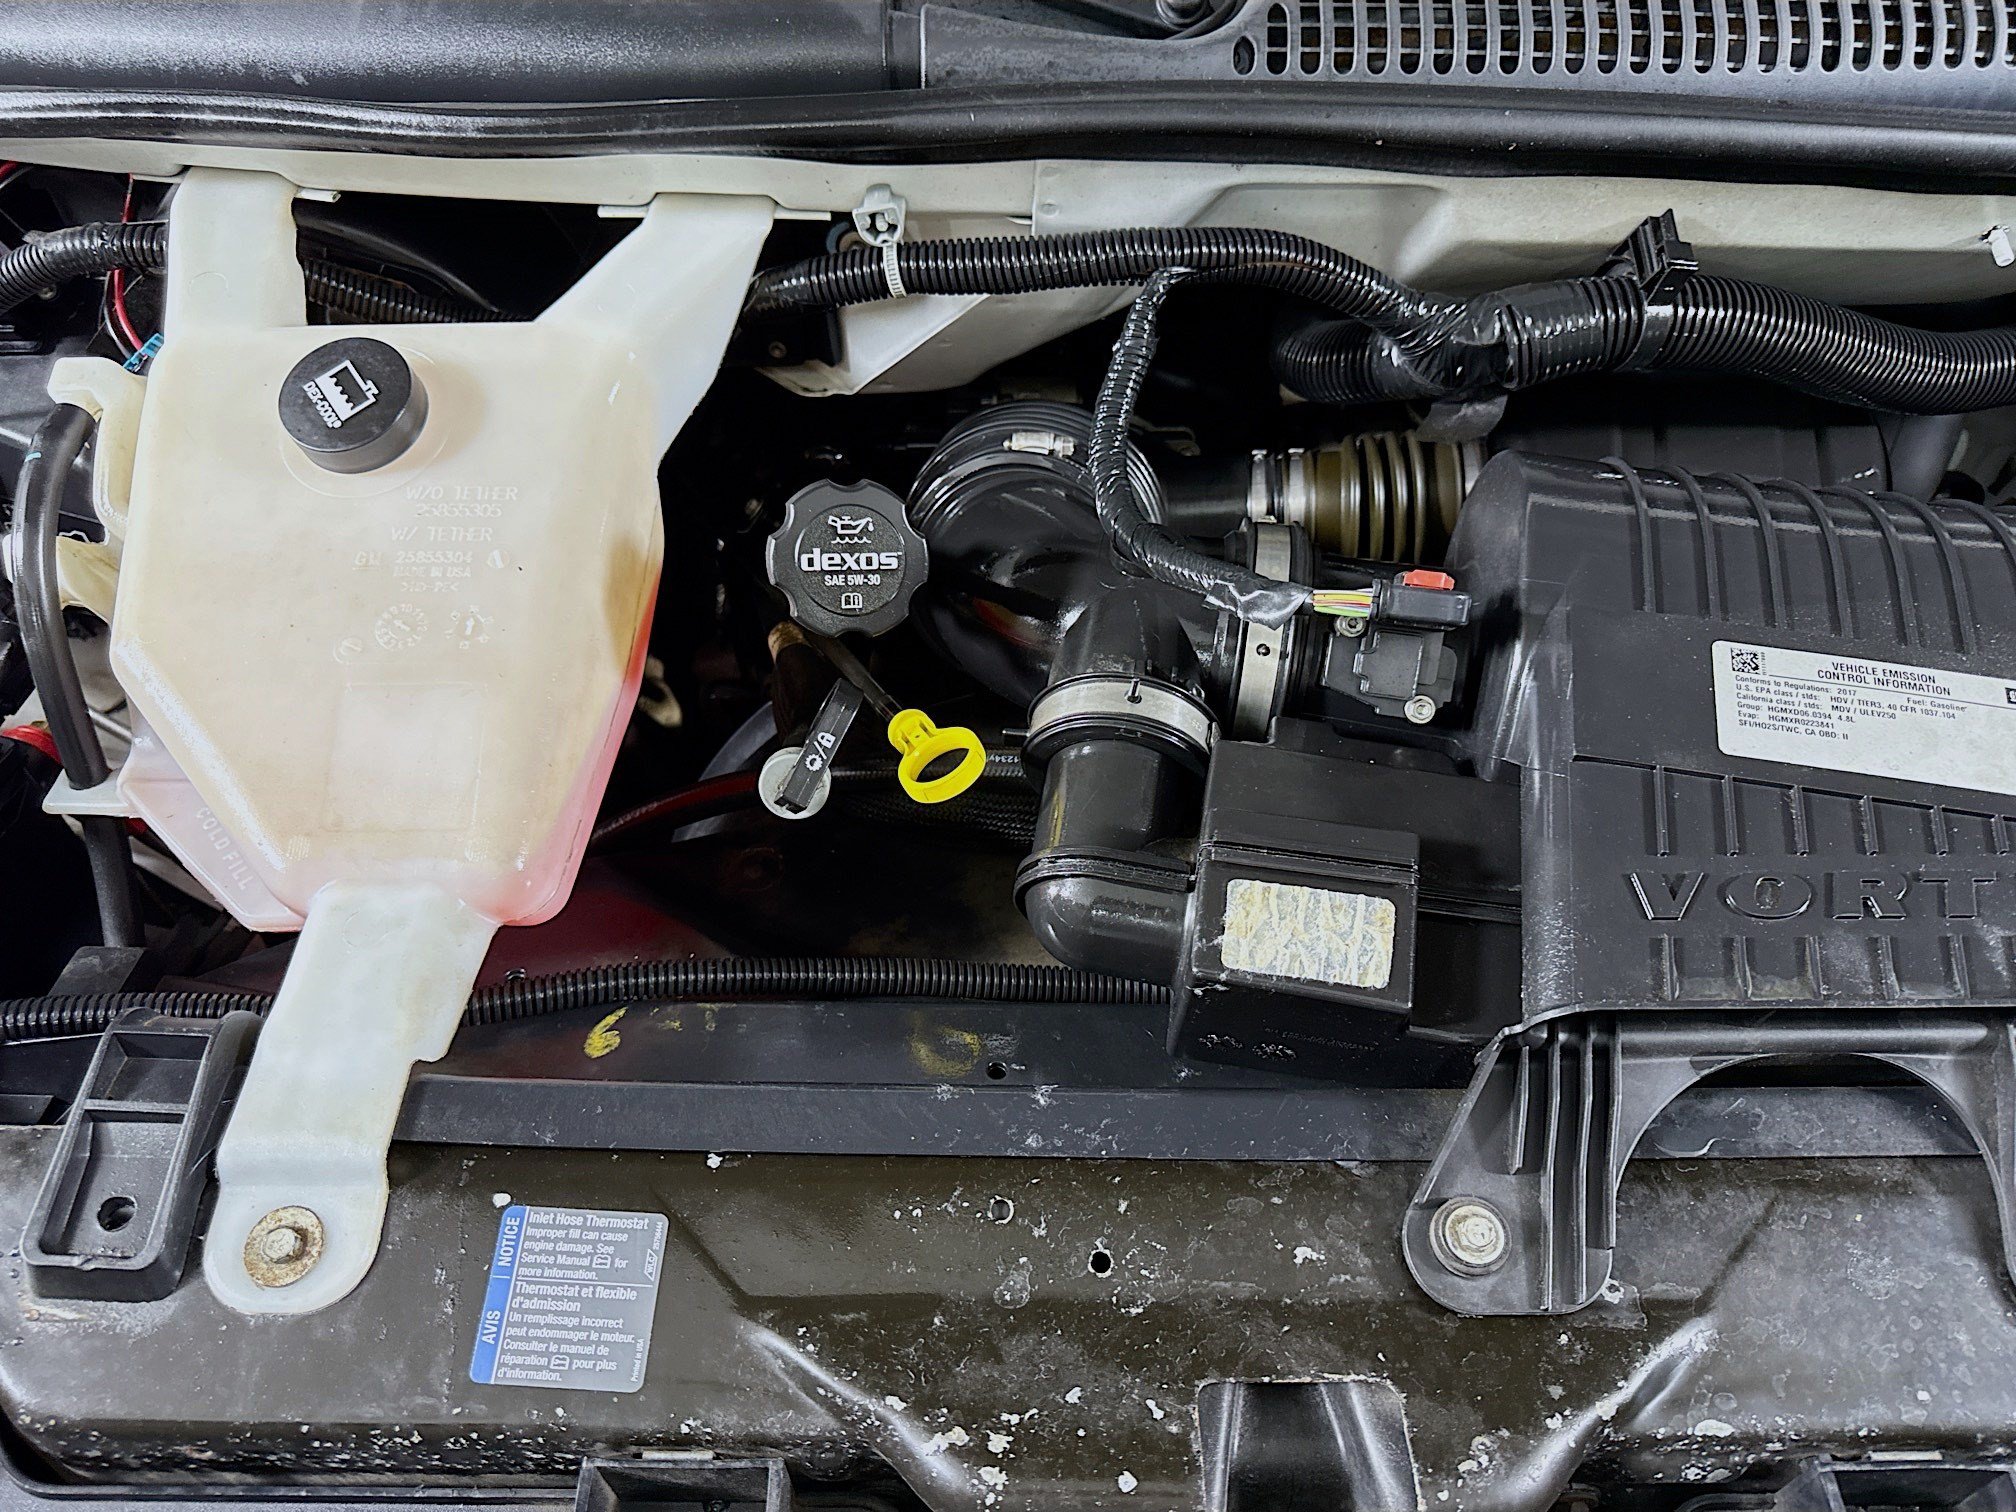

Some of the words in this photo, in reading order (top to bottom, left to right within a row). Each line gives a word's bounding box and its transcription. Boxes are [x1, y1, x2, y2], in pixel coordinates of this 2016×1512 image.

[455, 486, 518, 500] TETHER
[427, 526, 493, 541] TETHER
[800, 548, 899, 571] dexos
[824, 573, 846, 586] SAE
[847, 573, 881, 586] 5W-30
[1832, 661, 1878, 676] VEHICLE
[1883, 668, 1936, 684] EMISSION
[1735, 675, 1771, 686] Conforms
[1785, 681, 1831, 693] Regulations:
[1837, 688, 1856, 696] 2017
[1817, 670, 1870, 685] CONTROL
[1874, 676, 1951, 696] INFORMATION
[1736, 693, 1773, 704] California
[1776, 698, 1795, 707] class
[1804, 701, 1823, 710] stds:
[1831, 705, 1850, 713] MDV
[1860, 707, 1896, 719] ULEV250
[1737, 701, 1762, 711] Group:
[1755, 686, 1771, 694] EPA
[1774, 689, 1793, 698] class
[1801, 692, 1820, 701] stds:
[1830, 696, 1848, 704] HDV
[1900, 704, 1917, 713] CFR
[1907, 697, 1927, 707] Fuel:
[1738, 711, 1759, 719] Evap:
[1805, 728, 1816, 736] CA
[195, 807, 231, 850] COLD
[222, 852, 254, 890] FILL
[529, 1211, 554, 1225] Inlet
[556, 1214, 583, 1226] Hose
[586, 1215, 649, 1230] Thermostat
[498, 1217, 520, 1267] NOTICE
[526, 1226, 566, 1239] Improper
[569, 1228, 580, 1238] fill
[582, 1231, 599, 1240] can
[601, 1232, 628, 1242] cause
[524, 1240, 554, 1252] engine
[556, 1242, 594, 1254] damage.
[597, 1244, 615, 1254] See
[521, 1252, 555, 1264] Service
[557, 1254, 590, 1266] Manual
[614, 1258, 628, 1268] for
[518, 1267, 541, 1277] more
[544, 1267, 598, 1280] information.
[516, 1281, 579, 1297] Thermostat
[581, 1286, 594, 1297] et
[596, 1286, 637, 1300] flexible
[512, 1297, 580, 1312] d'admission
[482, 1310, 501, 1344] AVIS
[509, 1311, 521, 1322] Un
[524, 1314, 579, 1327] remplissage
[582, 1316, 623, 1329] incorrect
[506, 1326, 527, 1337] peut
[528, 1328, 589, 1342] endommager
[591, 1331, 599, 1340] le
[601, 1332, 634, 1343] moteur.
[503, 1339, 548, 1352] Consulter
[550, 1342, 559, 1352] le
[560, 1343, 594, 1354] manuel
[597, 1344, 609, 1356] de
[500, 1353, 548, 1368] réparation
[572, 1360, 594, 1370] pour
[596, 1359, 617, 1371] plus
[630, 1359, 641, 1382] Printed
[636, 1338, 645, 1352] USA
[497, 1368, 562, 1381] d'information.
